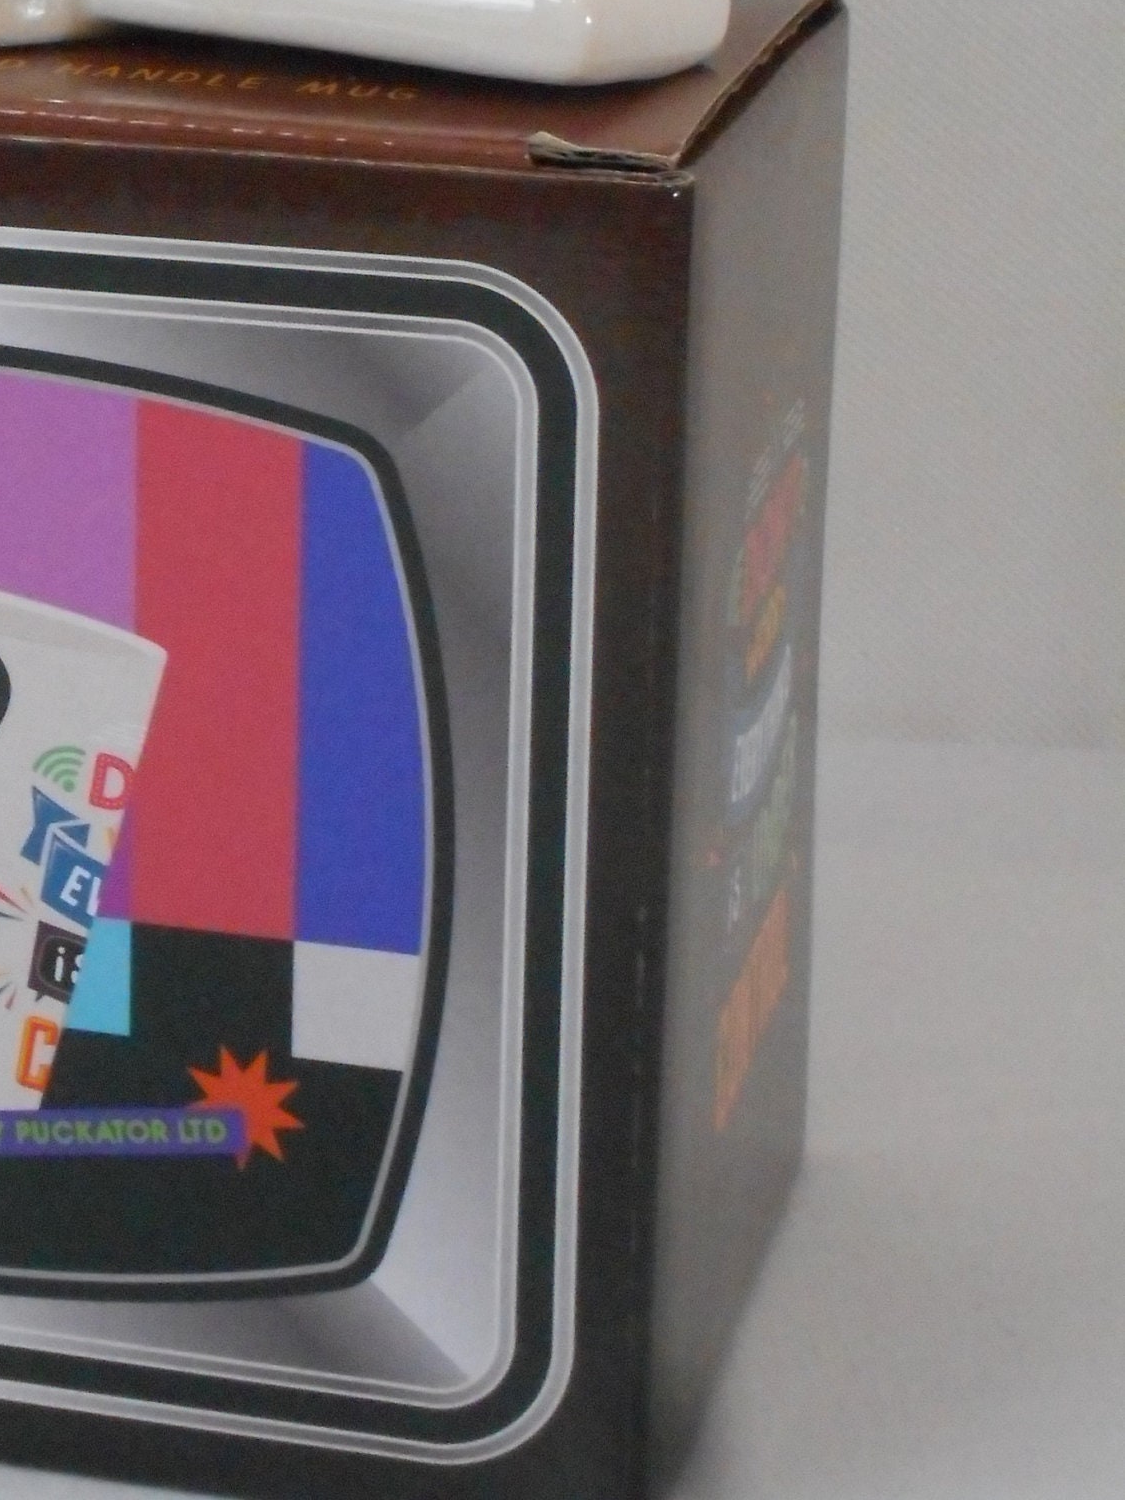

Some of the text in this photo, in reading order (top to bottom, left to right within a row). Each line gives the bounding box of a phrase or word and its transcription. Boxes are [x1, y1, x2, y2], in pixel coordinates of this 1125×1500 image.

[54, 62, 267, 90] HANDLE
[295, 78, 420, 101] MUG
[16, 1118, 170, 1146] PUCKATOR
[178, 1117, 228, 1144] LTD
